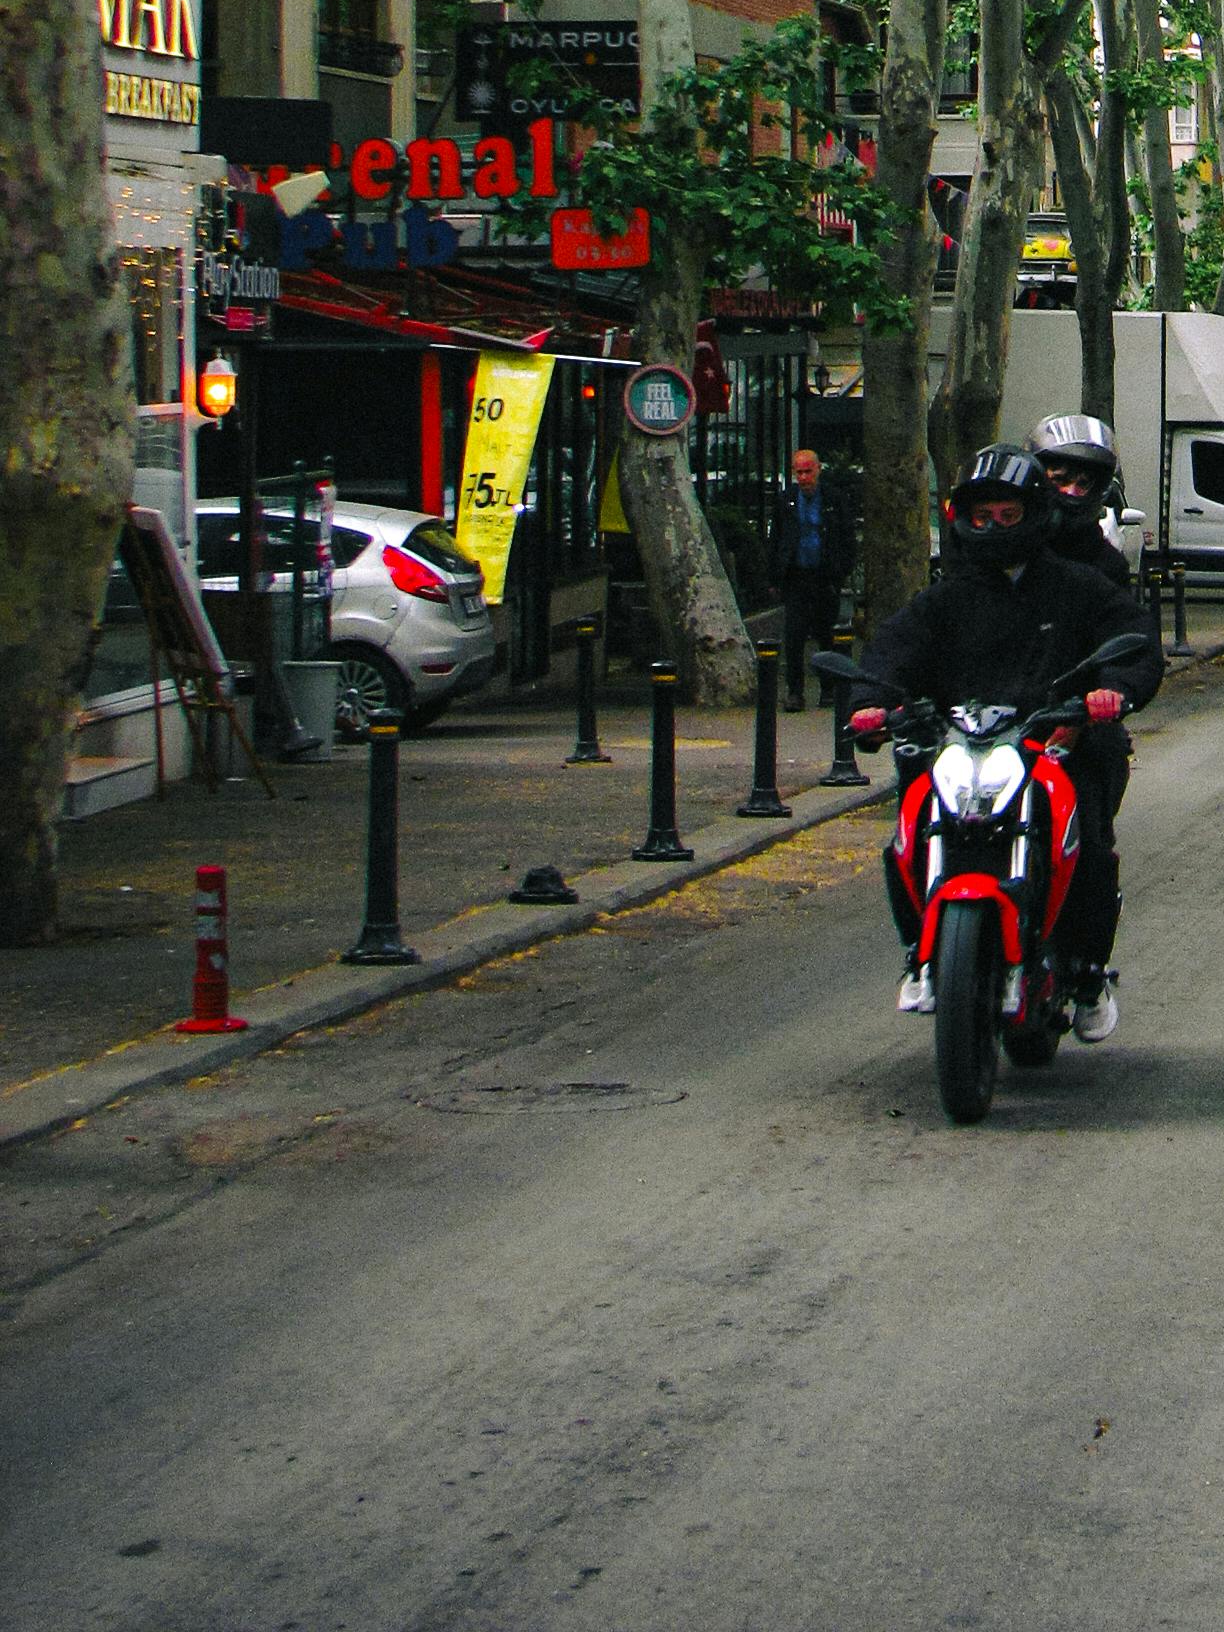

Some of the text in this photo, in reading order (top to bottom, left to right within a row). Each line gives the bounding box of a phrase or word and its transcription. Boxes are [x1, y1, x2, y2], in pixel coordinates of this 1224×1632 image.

[104, 71, 200, 126] BREAKFAST
[280, 202, 458, 267] Pub
[474, 398, 504, 423] 50
